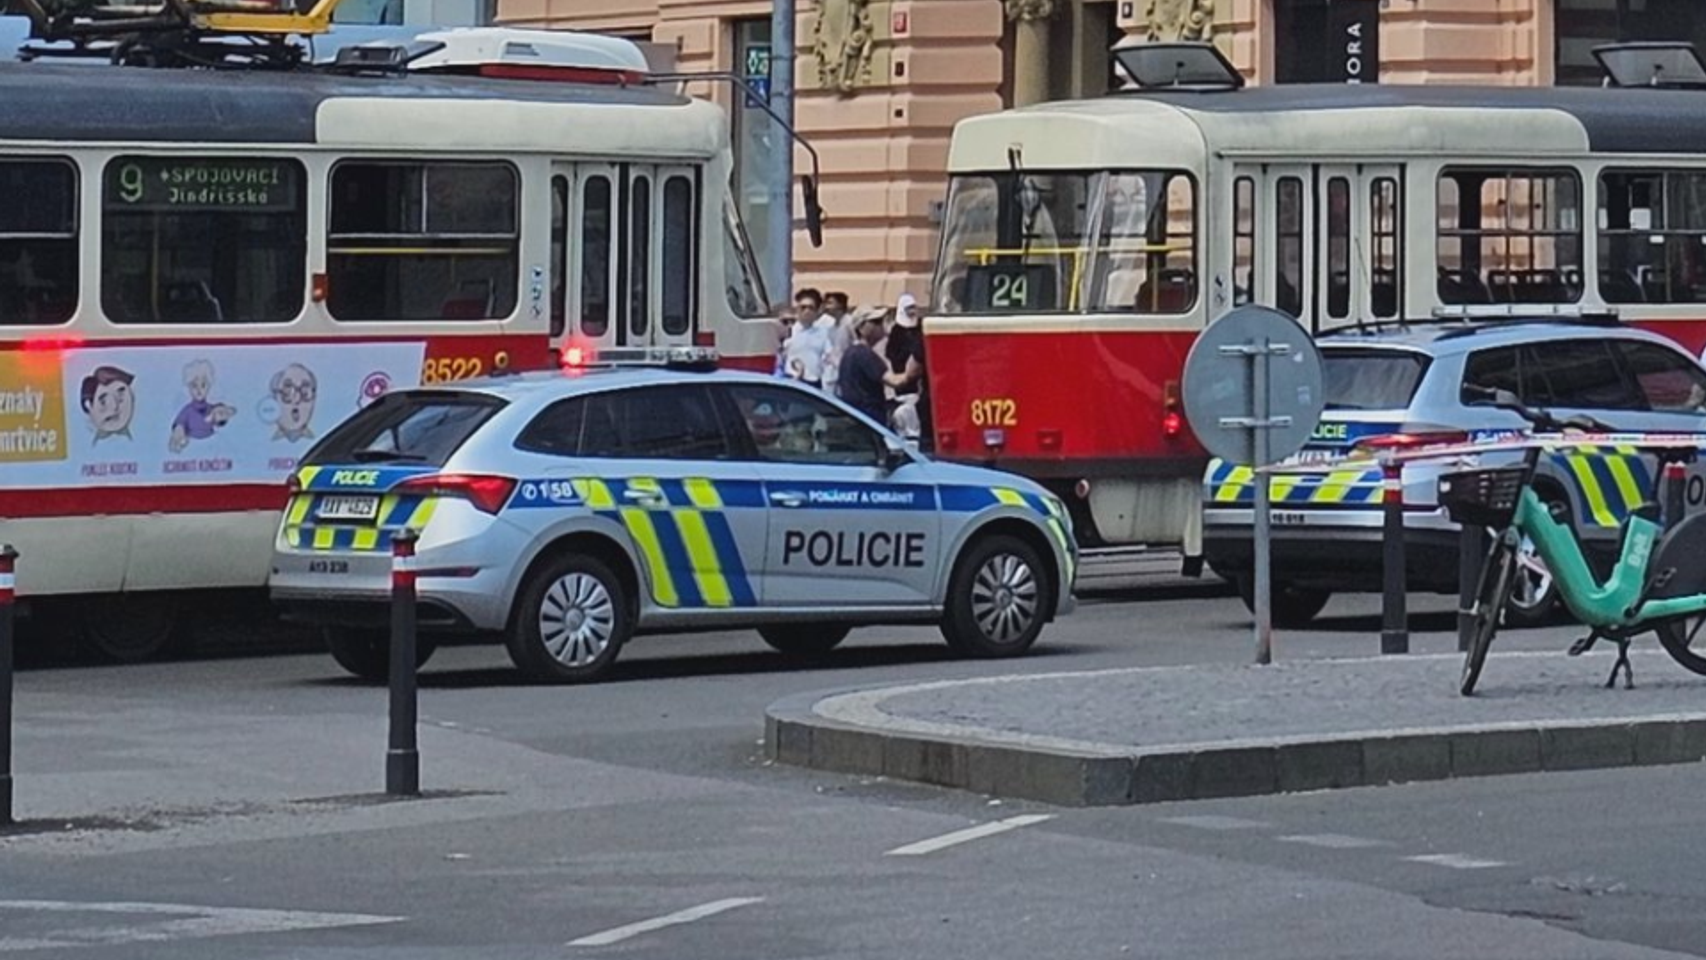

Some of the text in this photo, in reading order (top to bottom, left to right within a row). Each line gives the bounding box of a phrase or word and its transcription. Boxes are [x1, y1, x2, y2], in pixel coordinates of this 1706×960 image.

[1346, 22, 1362, 84] ORA
[119, 164, 142, 203] 9
[992, 274, 1027, 307] 24
[423, 357, 482, 385] 8522
[971, 398, 1018, 426] 8172
[330, 470, 380, 486] POLICIE
[539, 481, 573, 498] 158
[783, 530, 926, 568] POLICIE
